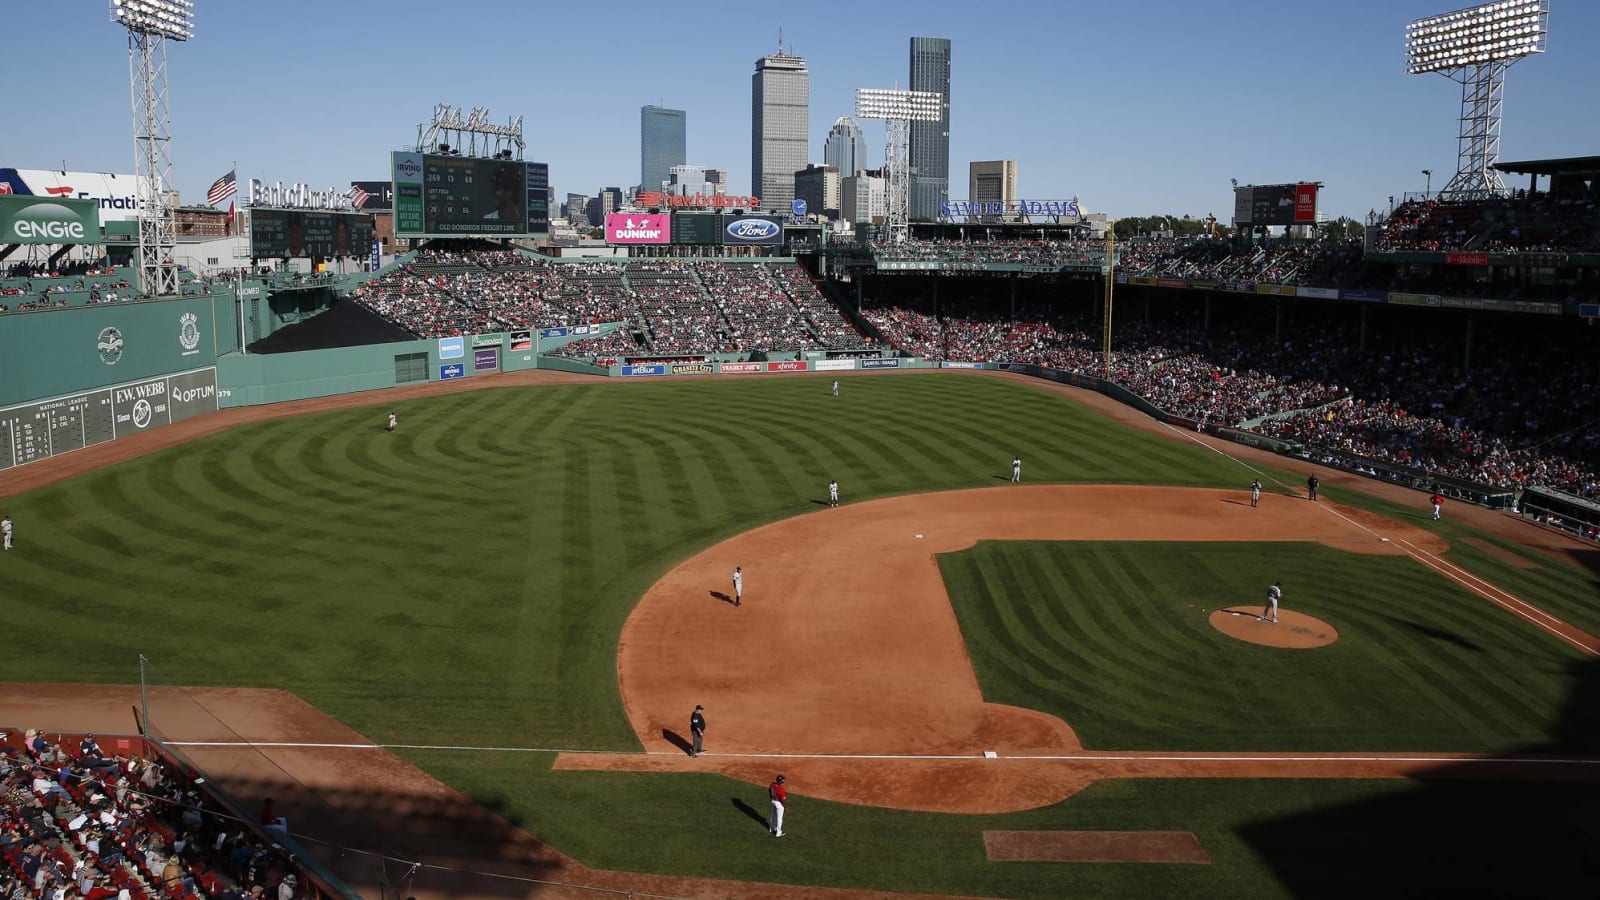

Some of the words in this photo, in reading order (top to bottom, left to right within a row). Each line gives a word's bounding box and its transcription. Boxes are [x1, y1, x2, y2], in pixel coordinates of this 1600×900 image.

[419, 103, 464, 148] John
[463, 106, 526, 149] Hancock
[398, 164, 421, 172] IRVING
[249, 179, 285, 206] Bank
[285, 183, 301, 206] of
[301, 184, 347, 209] America
[663, 193, 695, 207] new
[696, 192, 759, 208] balance
[941, 200, 1004, 217] SAMUEL
[1018, 199, 1079, 217] ADAMS
[616, 229, 661, 238] DUNKIN'
[737, 222, 768, 236] Ford
[632, 366, 655, 374] jetBlue
[673, 366, 699, 374] GRANITE
[777, 362, 798, 370] xfinity
[136, 382, 165, 398] WEBB
[183, 385, 214, 402] OPTUM
[40, 402, 66, 411] NATIONAL
[117, 413, 131, 423] Since
